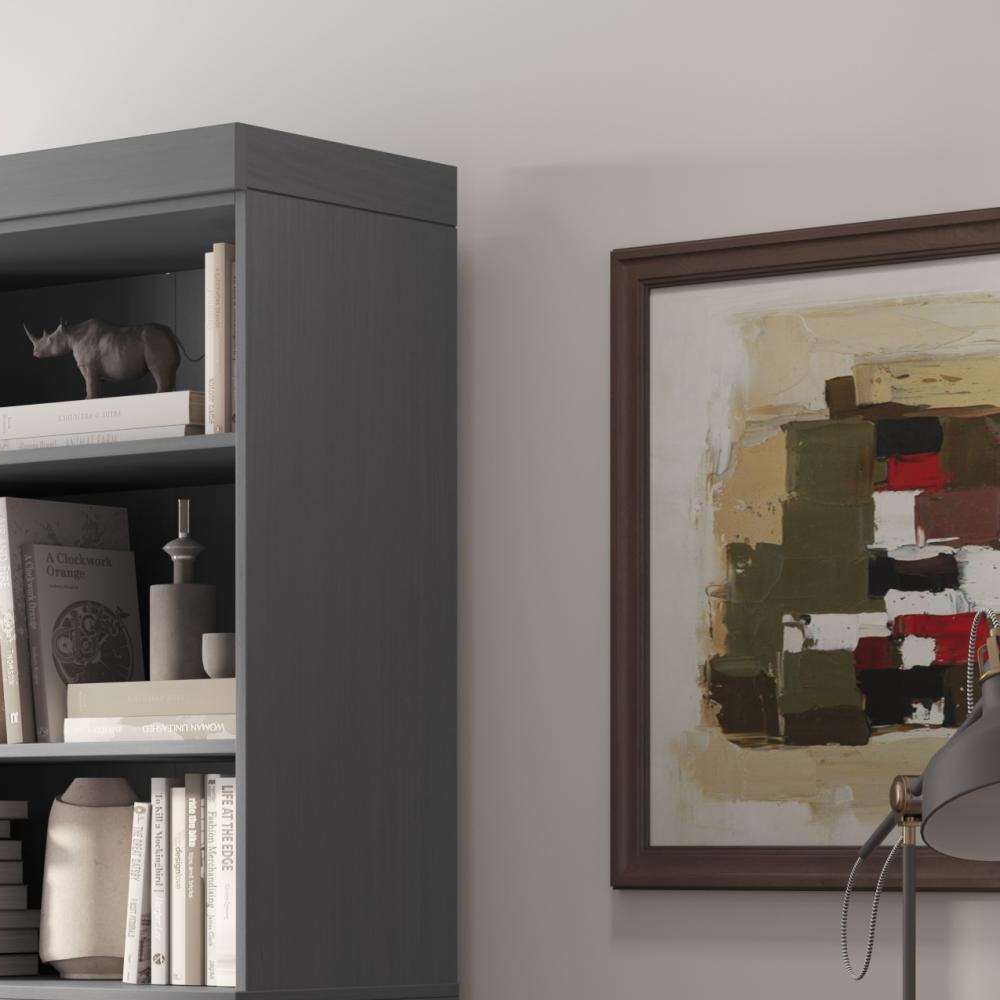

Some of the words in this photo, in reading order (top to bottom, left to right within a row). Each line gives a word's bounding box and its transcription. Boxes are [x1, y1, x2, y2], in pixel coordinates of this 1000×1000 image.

[46, 552, 54, 563] A
[57, 552, 112, 567] Clockwork
[47, 565, 85, 580] Orange
[221, 785, 233, 805] LIFE
[221, 808, 233, 821] AT
[221, 823, 233, 842] THE
[221, 844, 233, 871] EDGE
